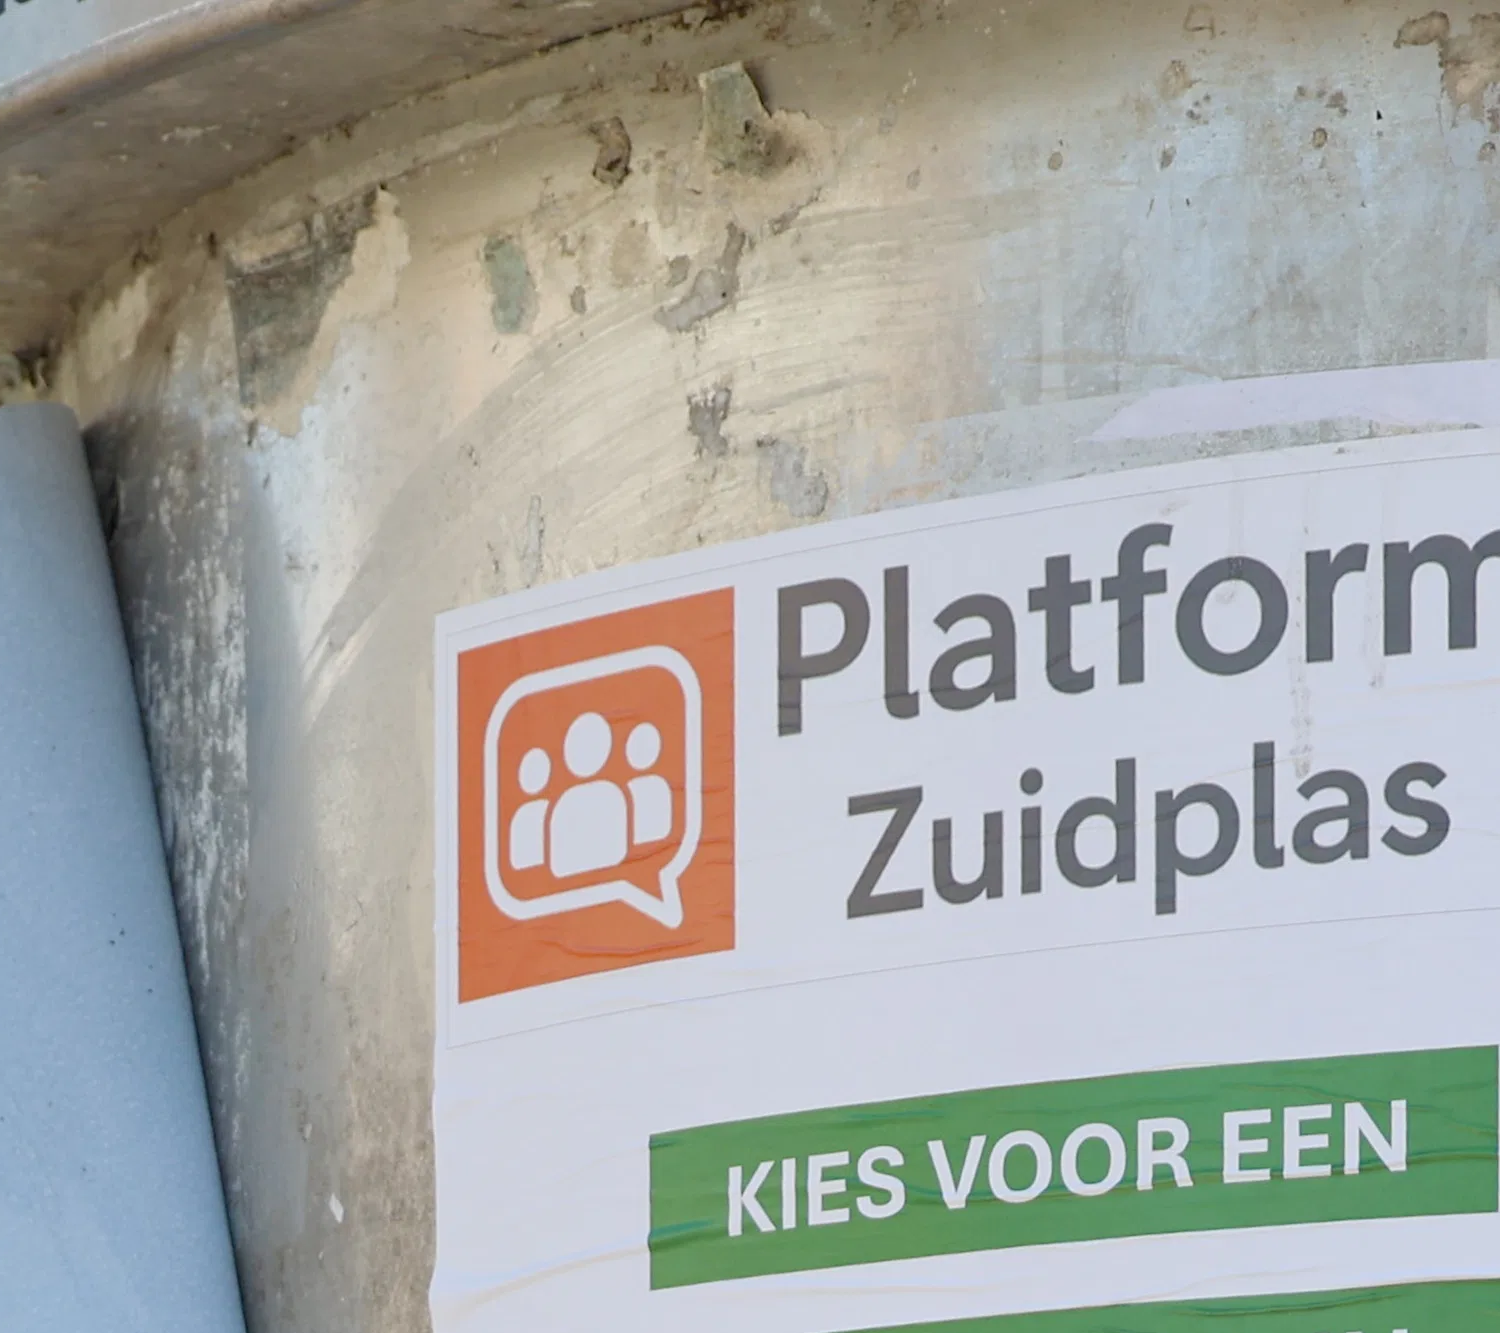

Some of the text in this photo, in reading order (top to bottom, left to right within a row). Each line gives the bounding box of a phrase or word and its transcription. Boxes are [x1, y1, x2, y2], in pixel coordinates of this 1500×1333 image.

[847, 741, 1451, 919] Zuidplas
[726, 1099, 1408, 1237] KIES VOOR EEN
